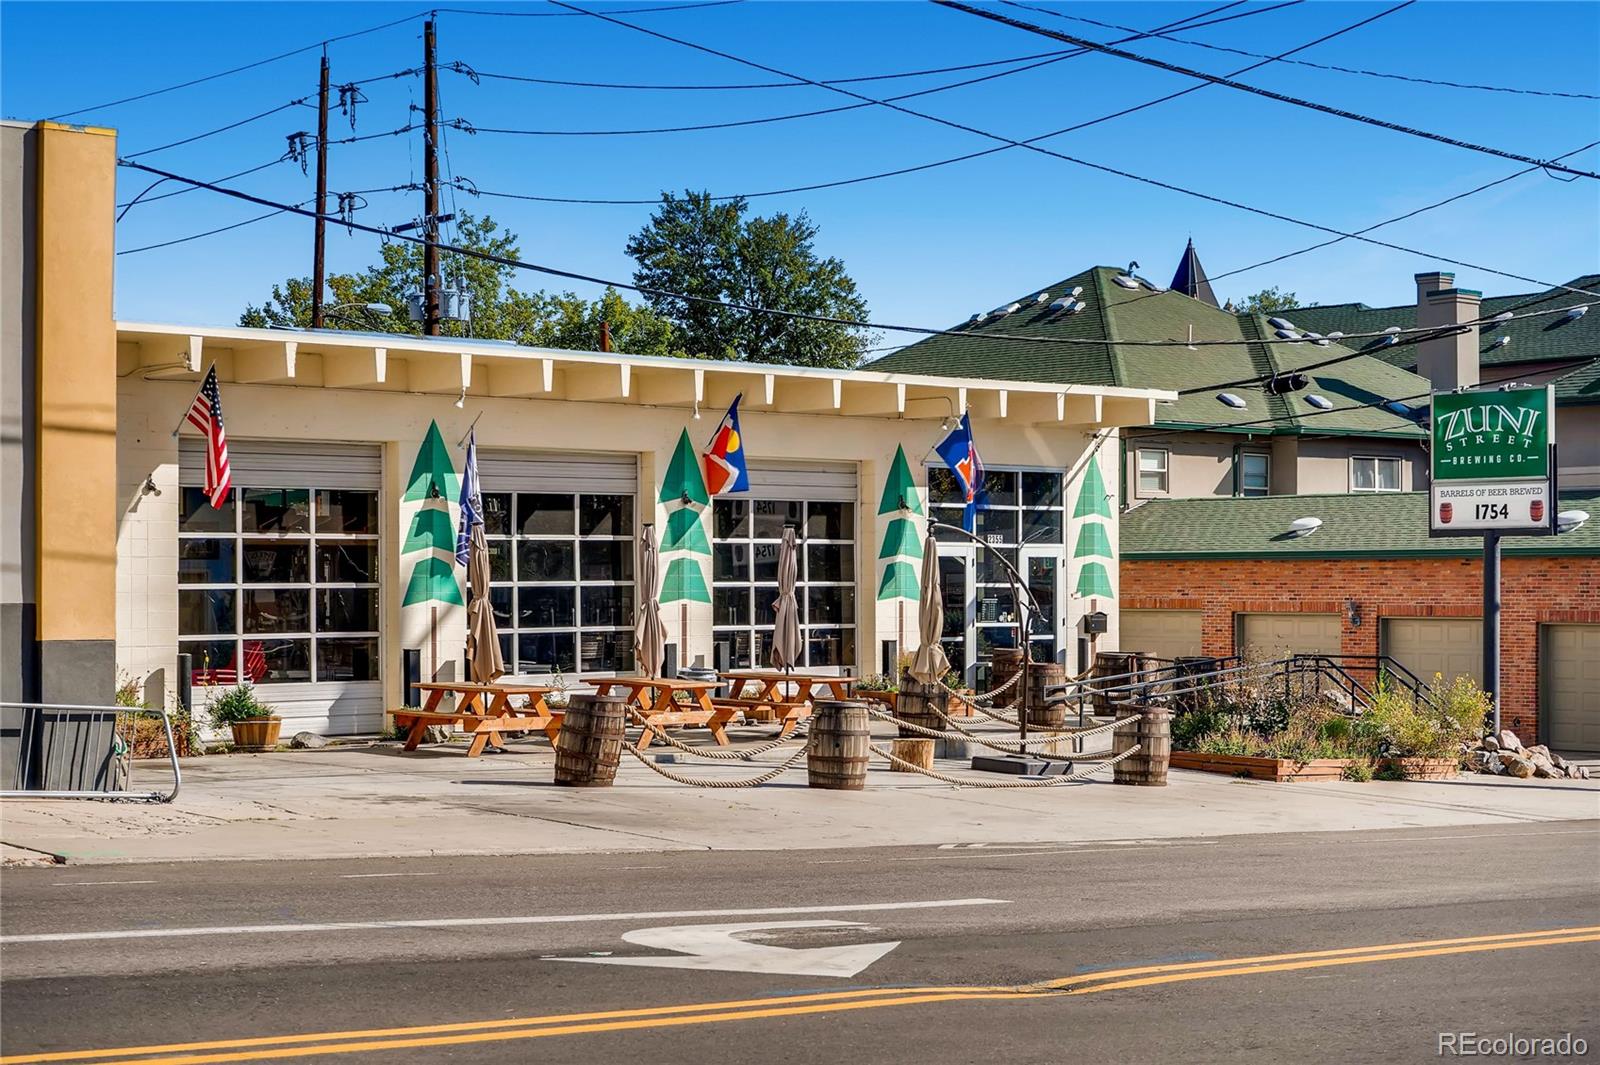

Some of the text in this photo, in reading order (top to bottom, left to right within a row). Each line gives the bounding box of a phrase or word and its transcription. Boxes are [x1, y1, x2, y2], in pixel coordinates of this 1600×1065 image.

[1437, 404, 1542, 441] ZUNI
[1446, 434, 1532, 452] STREET
[1452, 454, 1526, 465] BREWING CO.
[1440, 489, 1475, 498] BARRELS
[1487, 488, 1507, 496] BEER
[1509, 487, 1543, 496] BREWED
[1475, 503, 1509, 520] 1754
